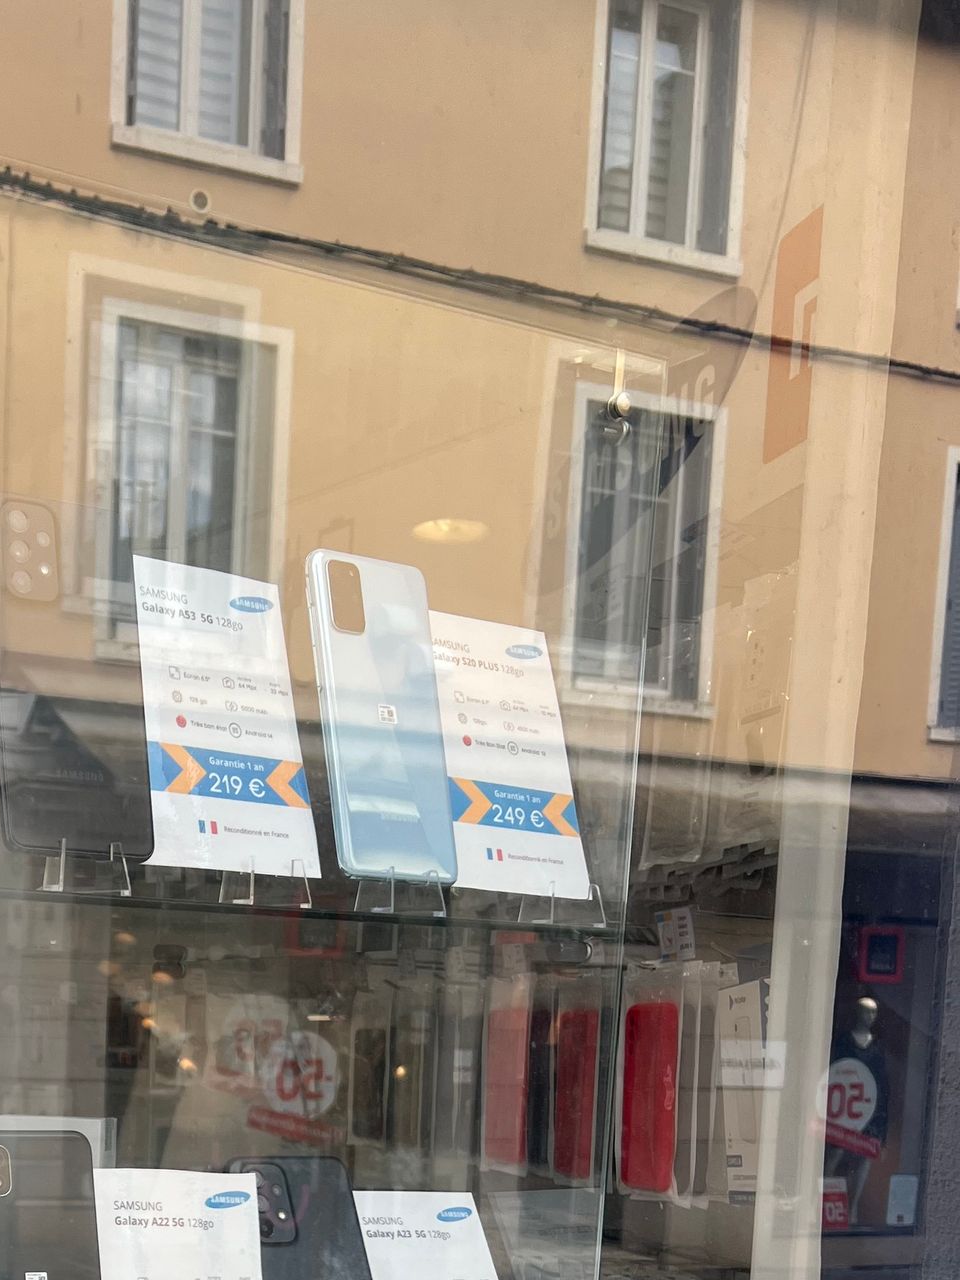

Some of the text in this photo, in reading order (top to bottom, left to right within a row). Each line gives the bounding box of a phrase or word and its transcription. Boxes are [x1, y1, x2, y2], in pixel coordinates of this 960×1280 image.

[139, 586, 188, 605] SAMSUNG
[142, 601, 243, 632] Galaxy A53 5G 128go
[432, 651, 460, 666] Galaxy
[462, 656, 476, 668] S20
[478, 660, 499, 672] PLUS
[209, 756, 265, 772] Garantie 1 an
[208, 772, 266, 798] 219 €
[494, 789, 525, 802] Garantie
[531, 796, 541, 804] an
[491, 804, 545, 828] 249 €
[113, 1200, 163, 1212] SAMSUNG
[115, 1216, 215, 1230] Galaxy A22 5G 128go
[362, 1216, 404, 1226] SAMSUNG
[366, 1229, 451, 1240] Galaxy A23 5G 128go
